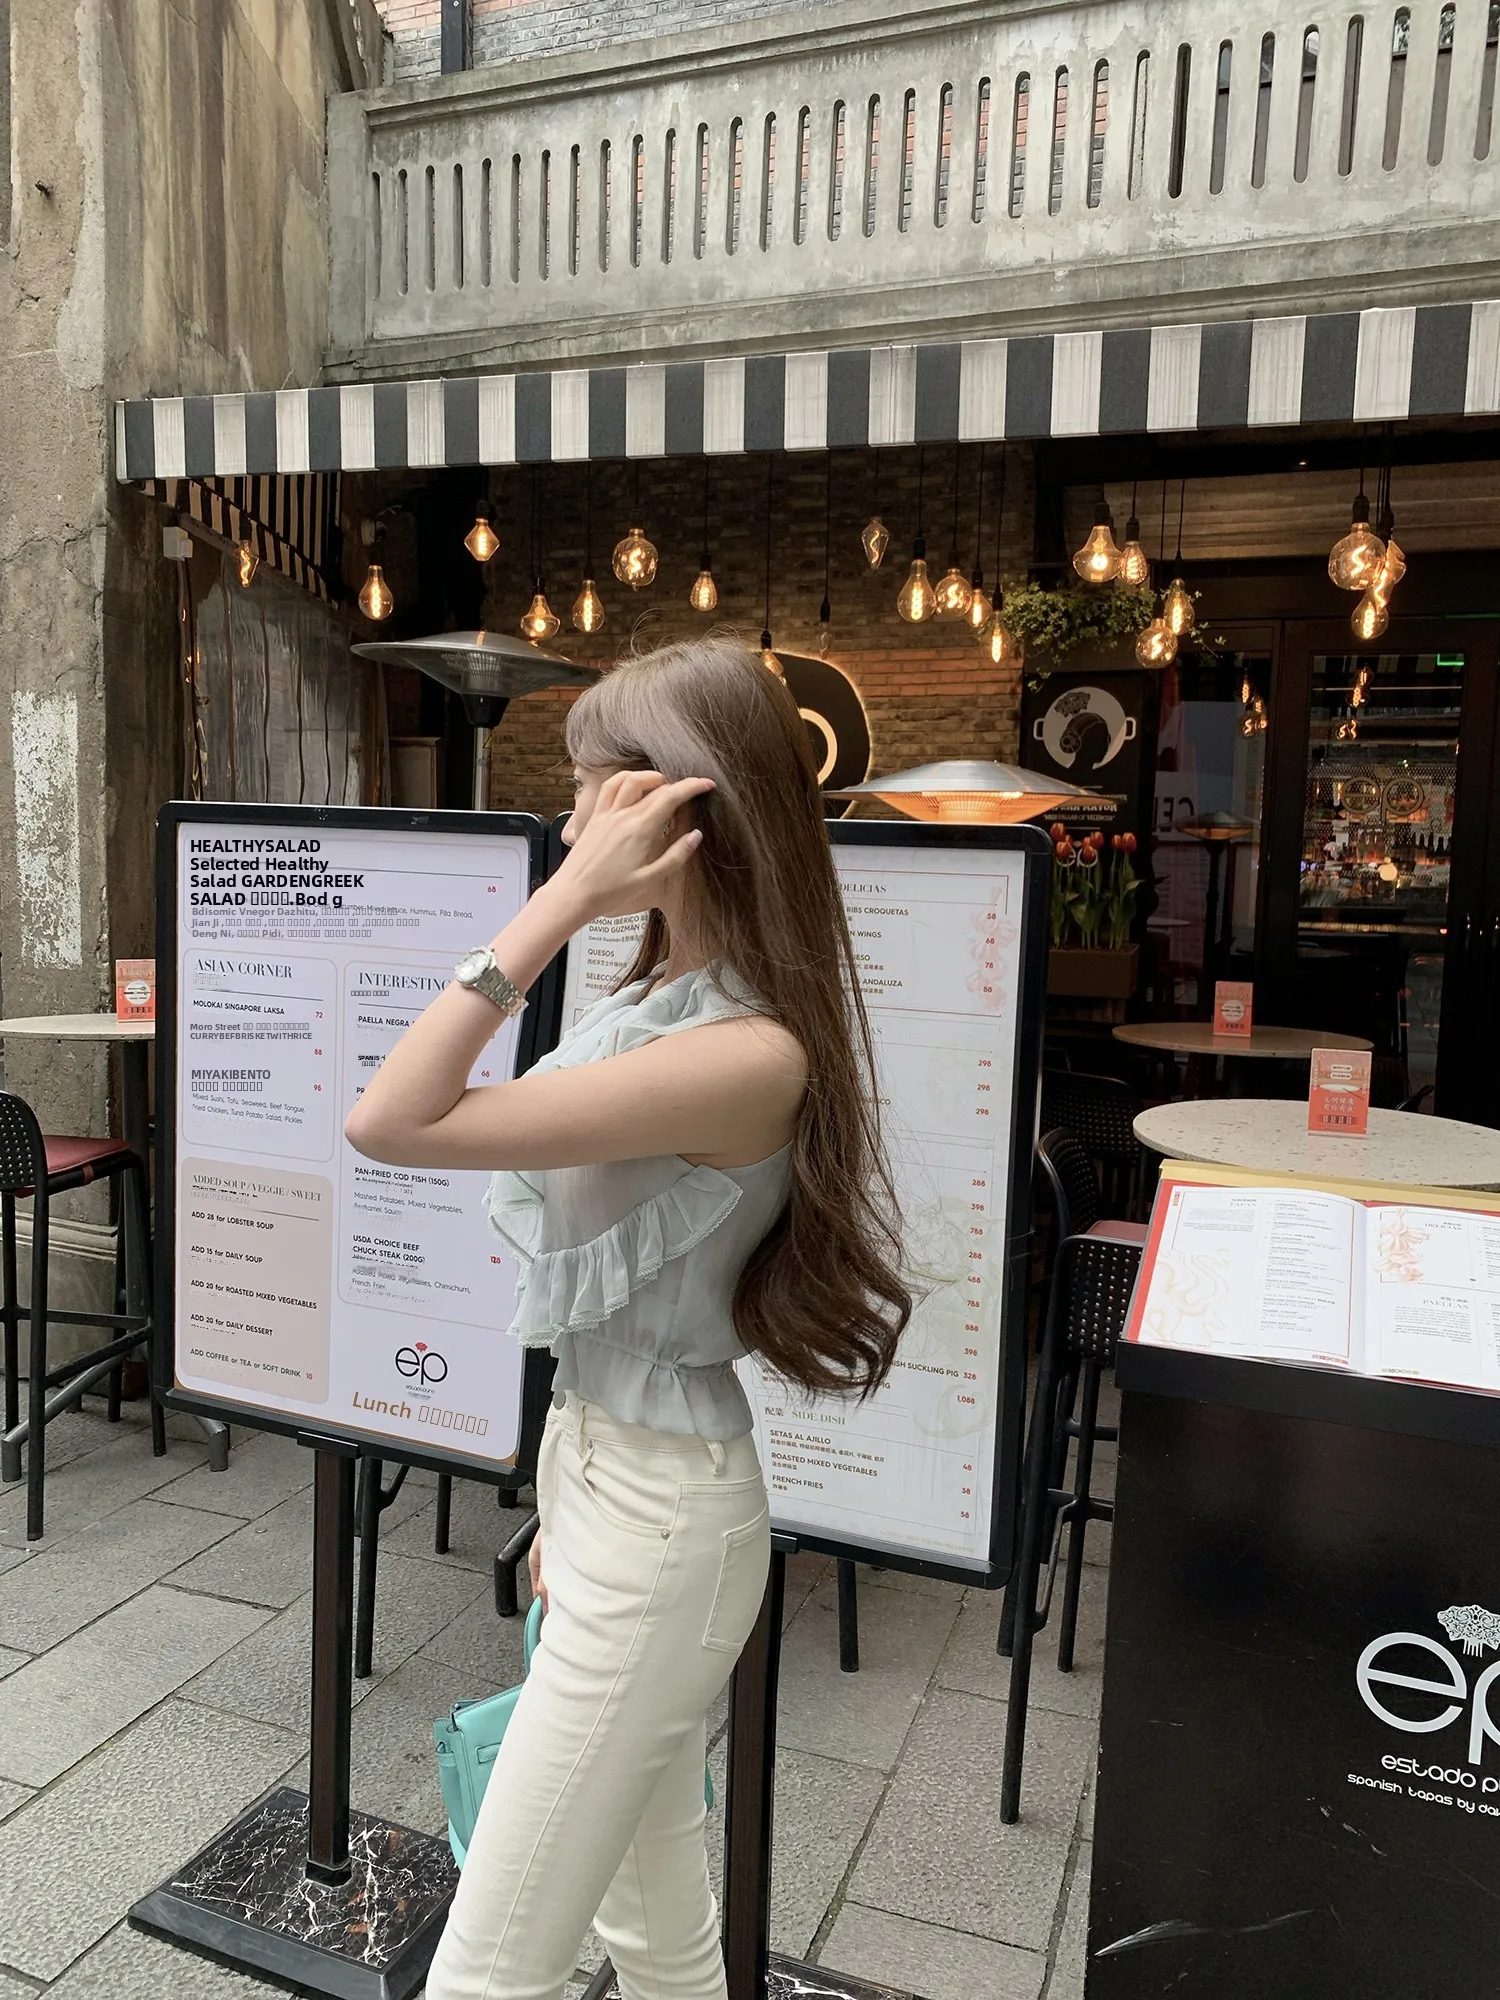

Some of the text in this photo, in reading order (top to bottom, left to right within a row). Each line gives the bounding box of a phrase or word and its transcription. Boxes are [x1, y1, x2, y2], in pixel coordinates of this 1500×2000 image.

[487, 885, 497, 894] 68
[439, 909, 474, 919] Pita Bread,
[846, 906, 997, 920] RIBS CROQUETAS 58
[589, 925, 610, 933] DAVID
[857, 931, 883, 939] WINGS
[985, 937, 996, 945] 68
[587, 949, 616, 958] QUESOS
[196, 958, 293, 978] ASIAN CORNER
[984, 961, 995, 970] 78
[862, 978, 994, 993] ANDALUZA 88
[193, 999, 324, 1019] MOLOKAI SINGAPORE LAKSA 72
[358, 1015, 410, 1027] PAELLA NEGRA
[977, 1059, 993, 1068] 298
[481, 1069, 490, 1077] 68
[313, 1084, 322, 1092] 98
[976, 1083, 991, 1092] 298
[207, 1106, 229, 1115] Chicken,
[231, 1108, 244, 1117] Tuna
[245, 1110, 264, 1119] Potato
[241, 1098, 267, 1109] Seaweed,
[269, 1102, 282, 1110] Beef
[284, 1103, 306, 1114] Tongue,
[975, 1107, 990, 1116] 298
[354, 1166, 450, 1187] PAN-FRIED COD FISH (150G)
[971, 1179, 987, 1188] 288
[193, 1174, 222, 1186] ADDED
[223, 1178, 246, 1190] SOUP
[252, 1182, 285, 1197] VEGGIE
[291, 1189, 322, 1202] SWEET
[354, 1191, 464, 1215] Mashed Potatoes, Mixed Vegetables,
[970, 1203, 985, 1212] 398
[191, 1211, 275, 1230] ADD 28 for LOBSTER SOUP
[969, 1227, 984, 1236] 788
[353, 1234, 420, 1252] USDA CHOICE BEEF
[191, 1245, 205, 1254] ADD
[206, 1247, 213, 1255] 15
[214, 1249, 224, 1257] for
[225, 1250, 244, 1260] DAILY
[245, 1254, 263, 1263] SOUP
[352, 1245, 426, 1264] CHUCK STEAK (200G)
[968, 1251, 983, 1260] 288
[352, 1277, 372, 1288] French
[434, 1280, 472, 1294] Chimichurri,
[967, 1275, 982, 1285] 488
[191, 1279, 318, 1310] ADD 20 for ROASTED MIXED VEGETABLES
[966, 1299, 980, 1309] 788
[190, 1314, 204, 1322] ADD
[205, 1316, 214, 1324] 20
[215, 1318, 224, 1326] for
[226, 1320, 244, 1330] DAILY
[245, 1324, 274, 1336] DESSERT
[964, 1324, 980, 1333] 888
[963, 1348, 979, 1357] 398
[190, 1348, 204, 1356] ADD
[205, 1351, 229, 1363] COFFEE
[239, 1358, 252, 1368] TEA
[262, 1363, 279, 1373] SOFT
[280, 1367, 301, 1378] DRINK
[306, 1372, 314, 1380] 10
[394, 1346, 449, 1386] ep
[906, 1362, 945, 1376] SUCKLING
[945, 1369, 960, 1379] PIG
[962, 1372, 978, 1381] 328
[352, 1391, 412, 1420] Lunch
[956, 1394, 976, 1405] 1,088
[792, 1409, 846, 1426] SIDE DISH
[770, 1429, 793, 1439] SETAS
[805, 1435, 832, 1445] AJILLO
[962, 1463, 973, 1472] 48
[771, 1452, 806, 1464] ROASTED
[806, 1458, 831, 1468] MIXED
[832, 1462, 879, 1477] VEGETABLES
[961, 1487, 971, 1496] 58
[772, 1474, 970, 1519] FRENCH FRIES 58
[1381, 1754, 1500, 1794] estado p
[1347, 1773, 1403, 1794] spanish
[1407, 1786, 1453, 1806] tapas
[1456, 1797, 1476, 1814] by
